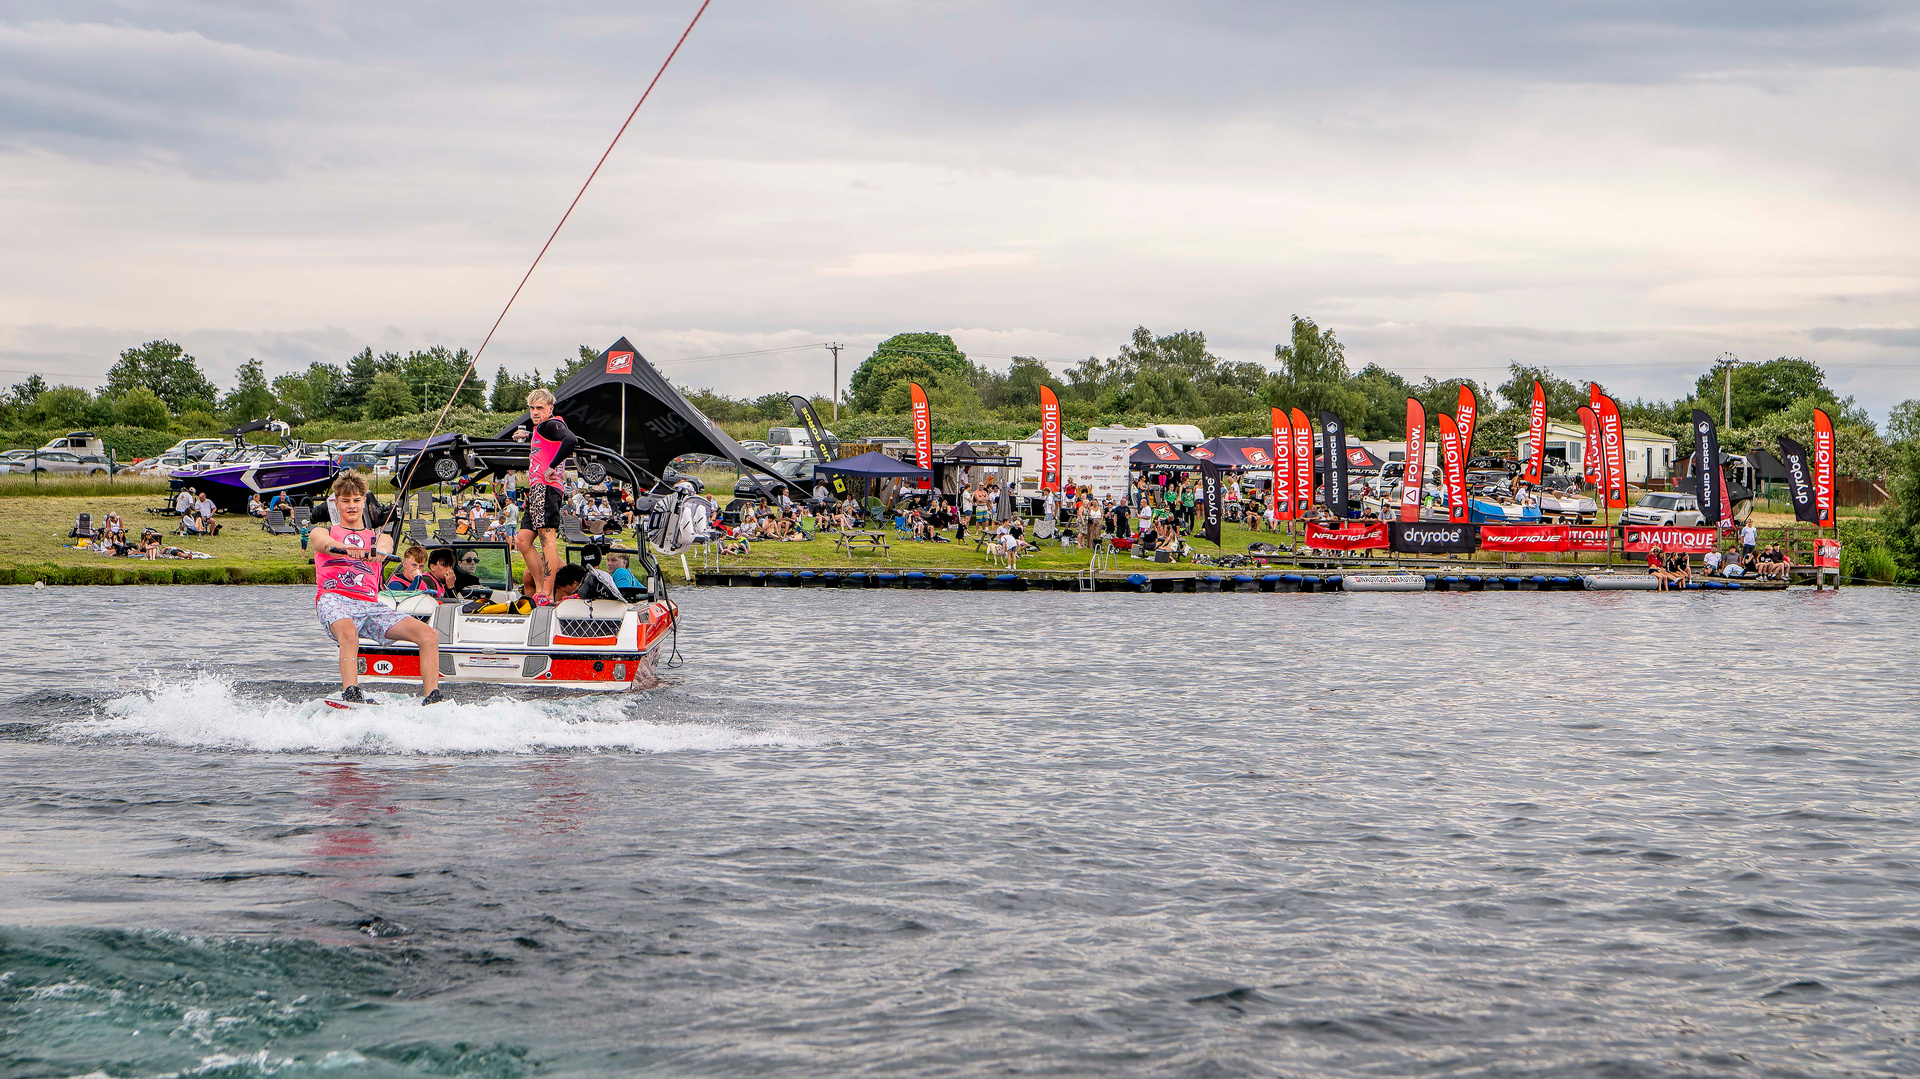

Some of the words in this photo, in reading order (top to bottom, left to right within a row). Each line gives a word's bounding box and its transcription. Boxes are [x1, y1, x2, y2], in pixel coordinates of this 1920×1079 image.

[801, 407, 821, 442] FORCE
[1330, 435, 1338, 469] FORCE
[1408, 424, 1422, 482] FOLLOW.
[1702, 435, 1710, 471] FORCE
[1311, 531, 1380, 542] NAUTIQUE
[1487, 535, 1562, 543] NAUTIQUE
[1640, 531, 1714, 547] NAUTIQUE
[465, 617, 526, 625] NAUTIQUE
[377, 663, 389, 671] UK
